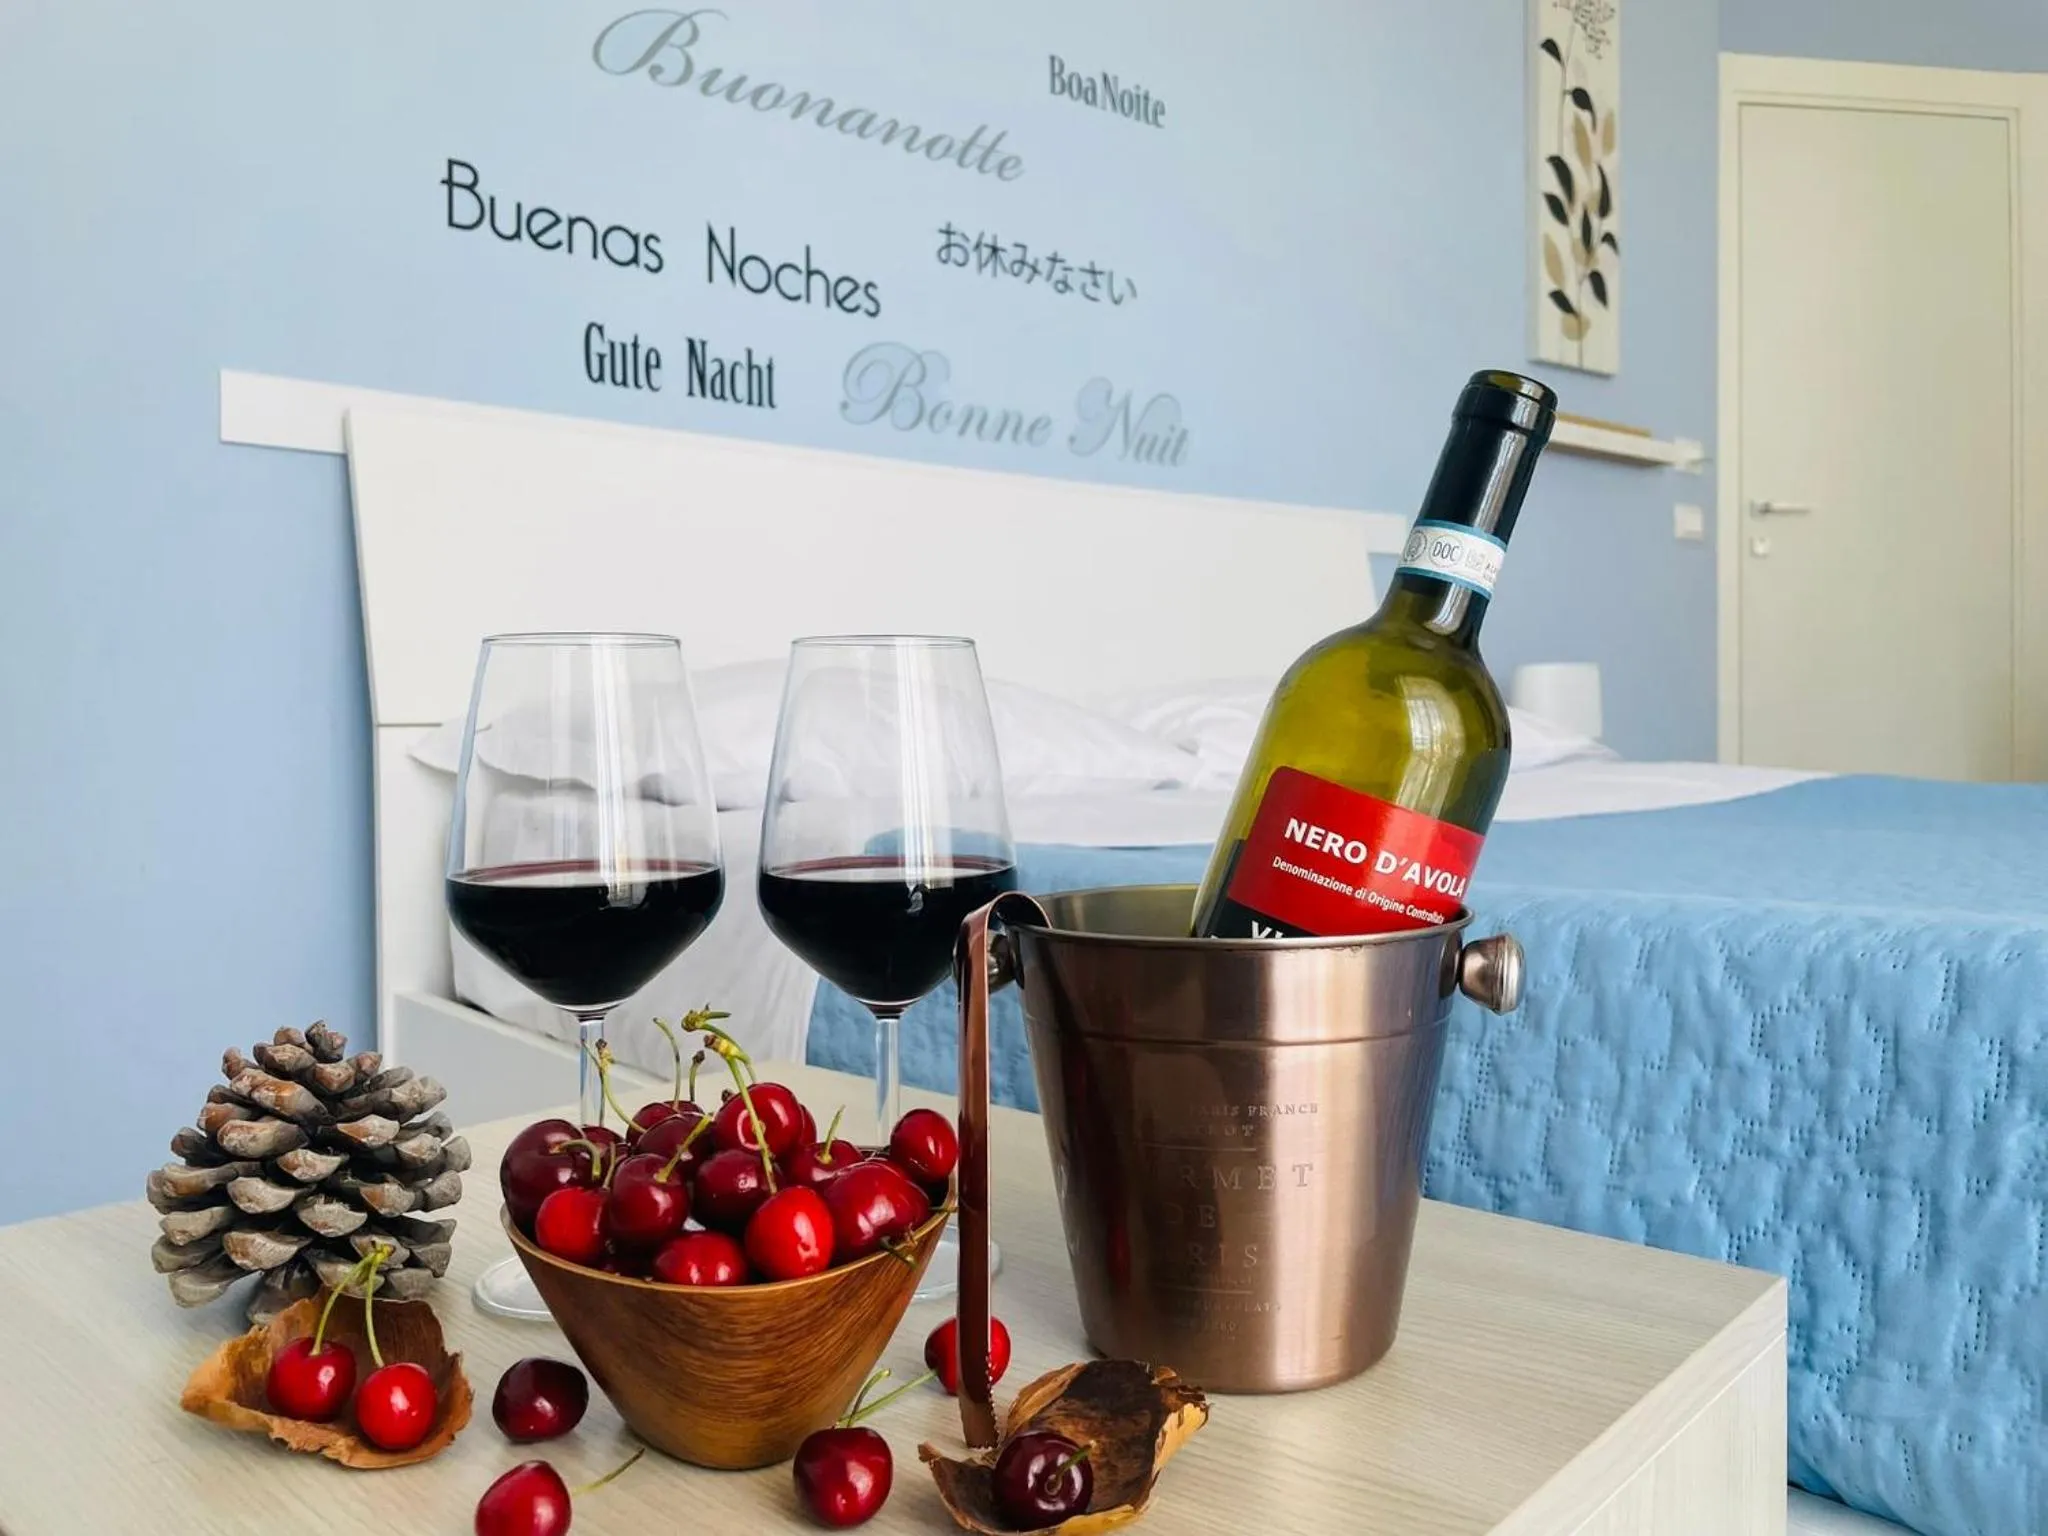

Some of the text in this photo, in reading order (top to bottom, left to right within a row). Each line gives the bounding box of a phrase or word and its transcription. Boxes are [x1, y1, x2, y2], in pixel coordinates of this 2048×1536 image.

[591, 9, 1025, 182] Buonanotte
[440, 158, 881, 318] Buenas Noches
[937, 221, 1138, 306] お休みなさい
[583, 321, 777, 409] Gute Nacht
[839, 341, 1190, 468] Bonne Nuit
[1432, 541, 1460, 562] DOC
[1272, 855, 1354, 896] Denominazione
[1354, 887, 1366, 901] di
[1367, 891, 1405, 914] Origine
[1283, 817, 1467, 898] NERO D'AVOLA
[1247, 1102, 1319, 1118] FRANCE
